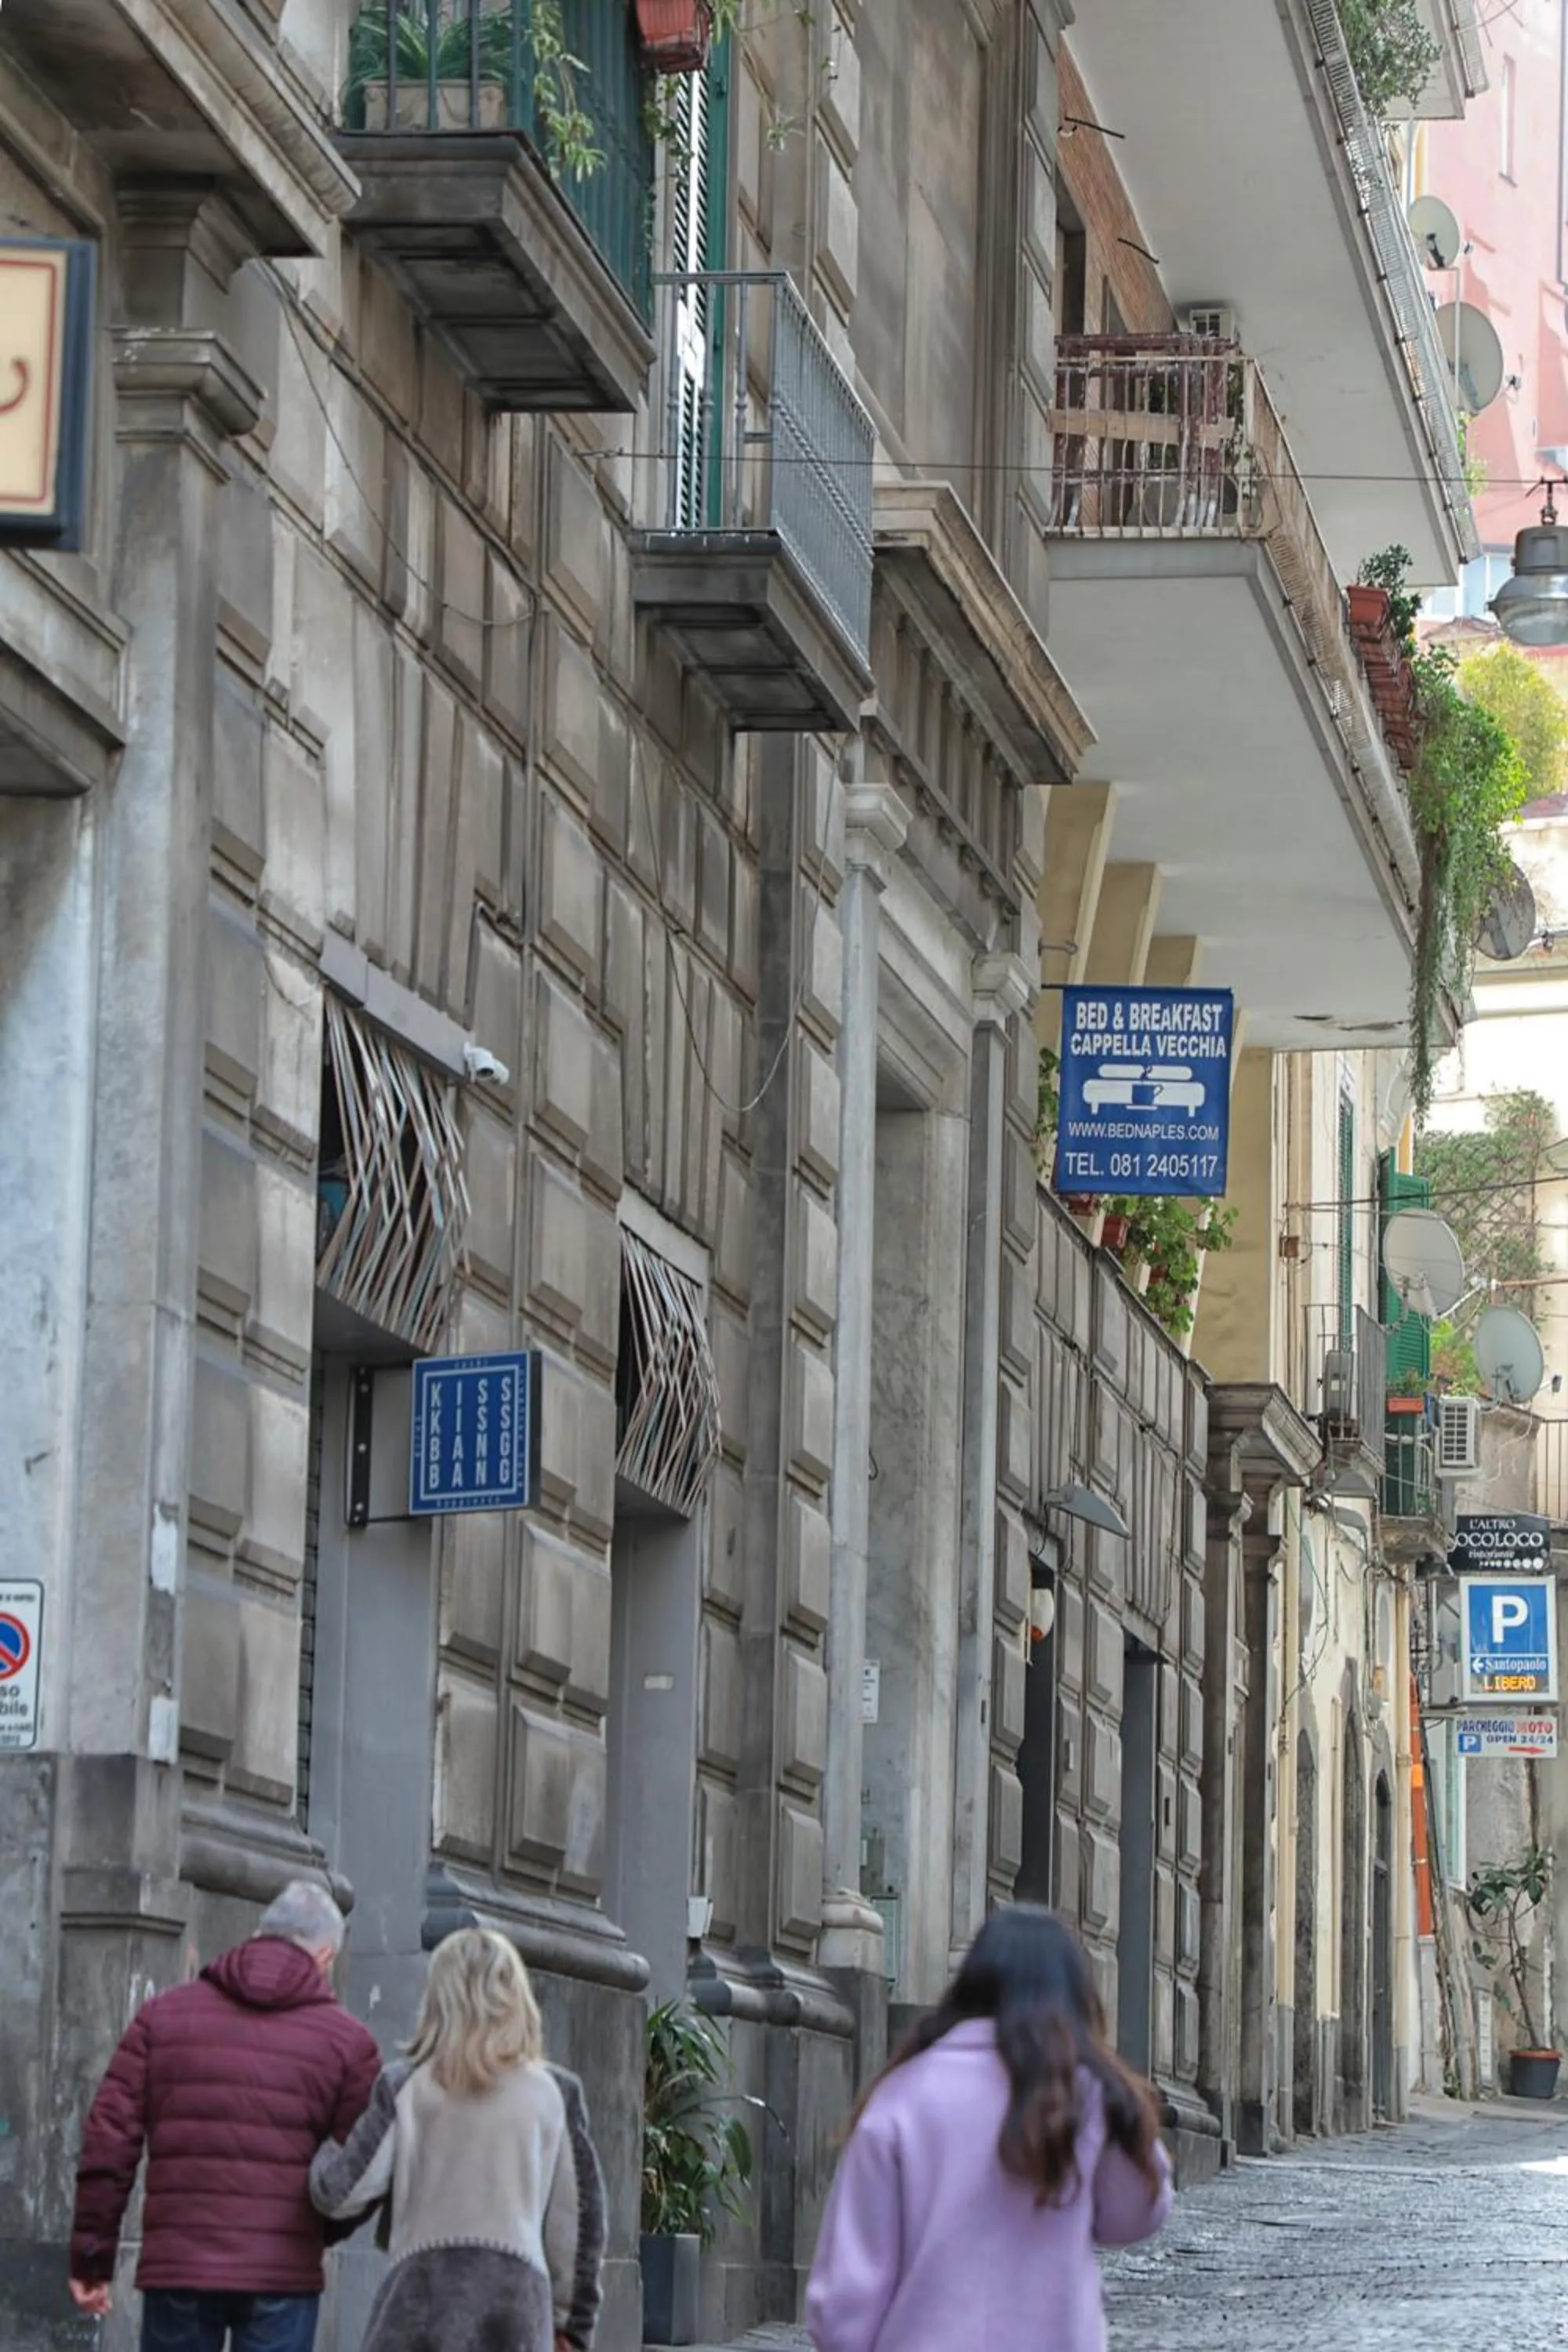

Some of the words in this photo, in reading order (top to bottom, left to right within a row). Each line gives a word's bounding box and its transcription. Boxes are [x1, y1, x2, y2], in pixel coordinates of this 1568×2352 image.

[1076, 1002, 1108, 1029] BED
[1112, 1002, 1124, 1029] &
[1130, 1003, 1222, 1033] BREAKFAST
[1071, 1033, 1152, 1056] CAPPELLA
[1156, 1036, 1226, 1058] VECCHIA
[1069, 1122, 1219, 1141] WWW.BEDNAPLES.COM
[1065, 1152, 1104, 1175] TEL.
[1110, 1153, 1140, 1176] 081
[1147, 1154, 1218, 1178] 2405117
[430, 1377, 511, 1408] KISS
[430, 1404, 511, 1436] KISS
[430, 1432, 511, 1462] BANG
[429, 1459, 510, 1490] BANG
[1470, 1519, 1515, 1530] L'ALTRO
[1456, 1532, 1543, 1547] OCOLOCO
[1493, 1595, 1528, 1643] P
[1457, 1719, 1515, 1733] PARCHEGGIO
[1516, 1722, 1553, 1734] MOTO
[1463, 1737, 1477, 1751] P
[1486, 1735, 1516, 1744] OPEN
